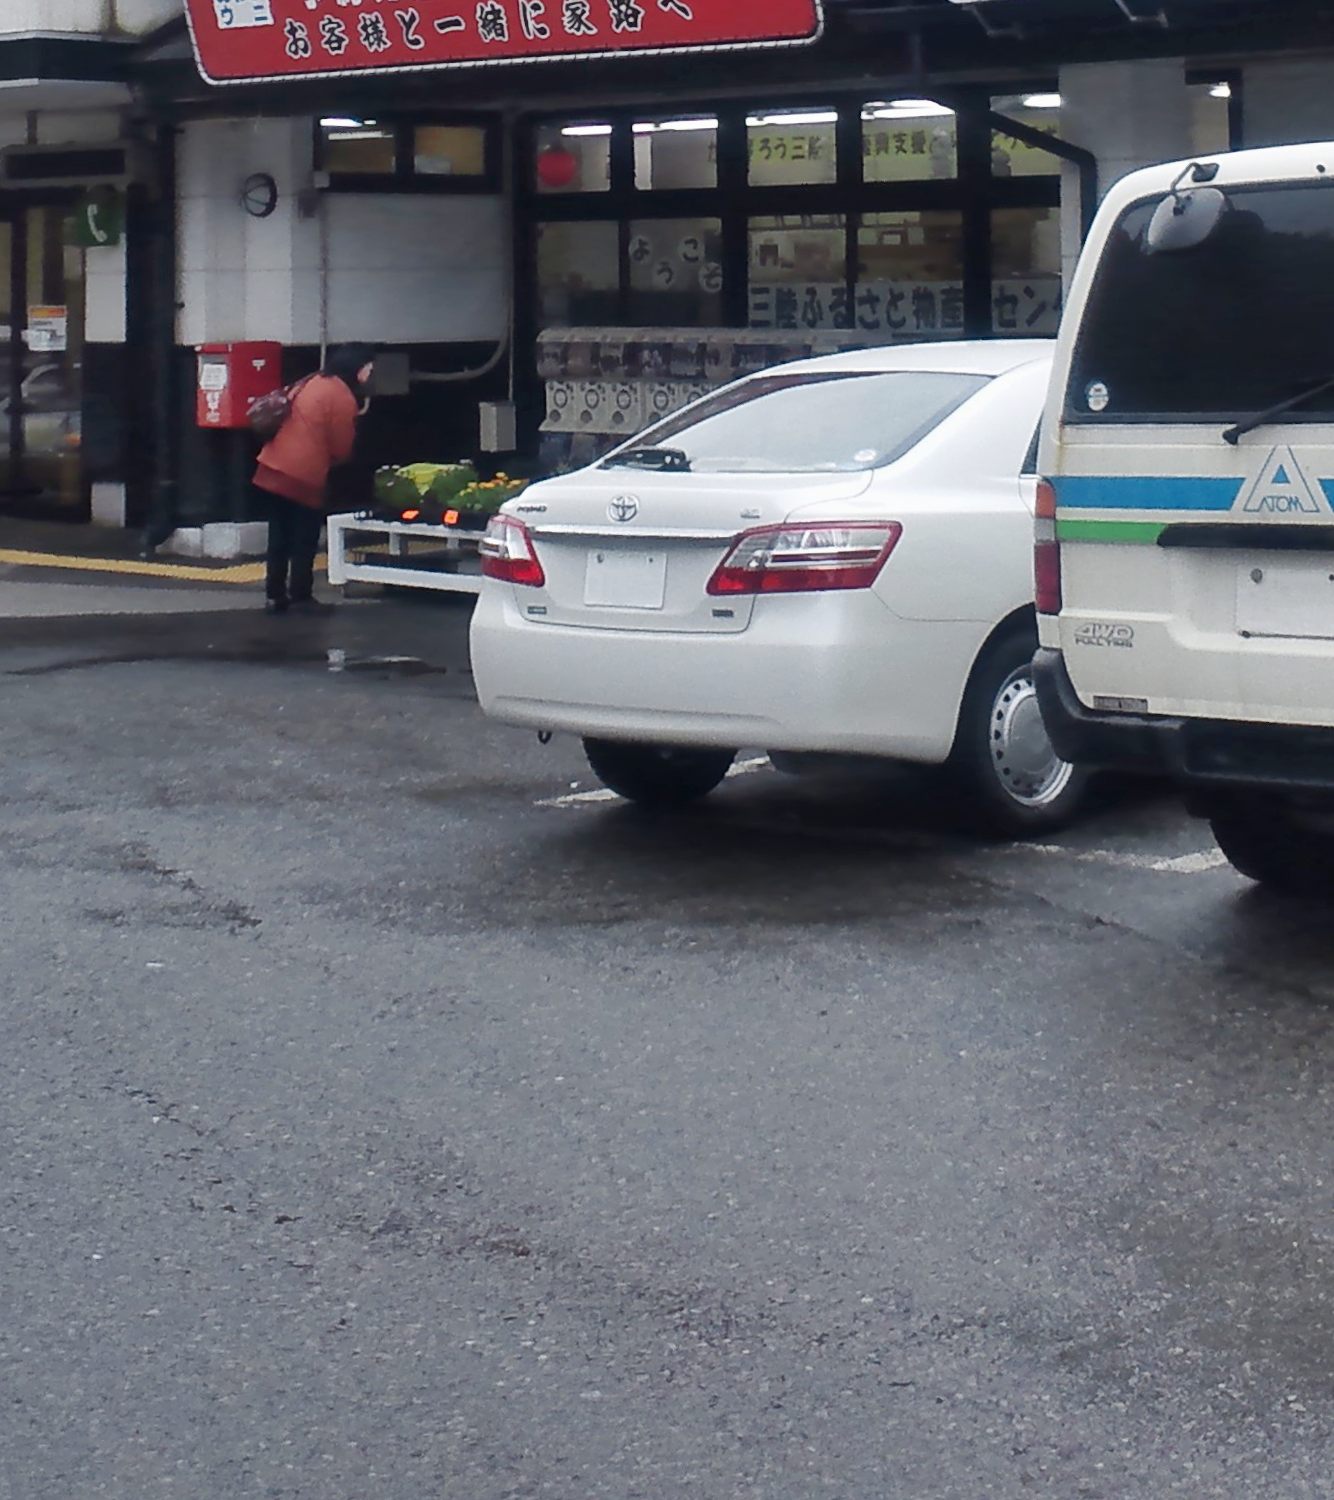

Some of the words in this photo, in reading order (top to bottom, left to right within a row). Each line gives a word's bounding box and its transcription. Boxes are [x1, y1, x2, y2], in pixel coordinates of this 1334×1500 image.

[220, 4, 269, 26] ウニ
[1258, 495, 1304, 512] ATOM
[1074, 623, 1134, 639] 4WD
